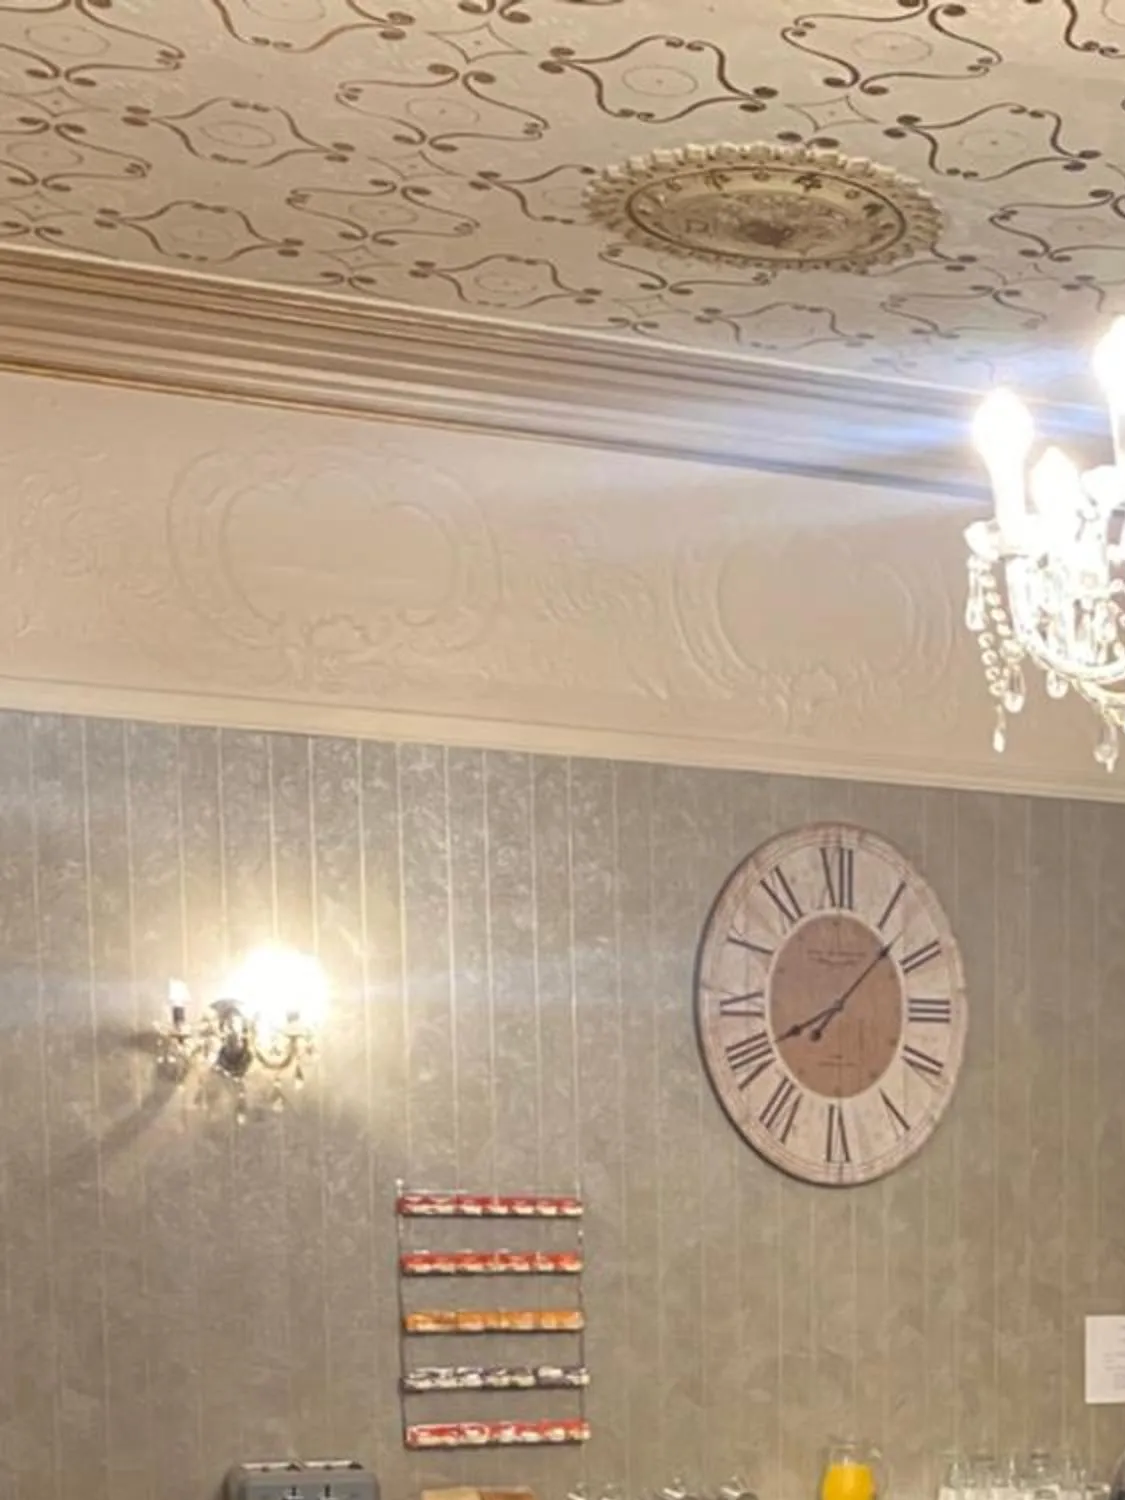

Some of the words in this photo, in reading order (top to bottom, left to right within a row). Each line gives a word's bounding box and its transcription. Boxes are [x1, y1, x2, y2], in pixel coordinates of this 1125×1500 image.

[817, 847, 854, 911] XII
[877, 880, 907, 929] I
[899, 939, 942, 973] II
[908, 998, 951, 1023] III
[726, 1031, 776, 1090] VIII
[758, 1076, 804, 1145] VII
[826, 1104, 851, 1163] VI
